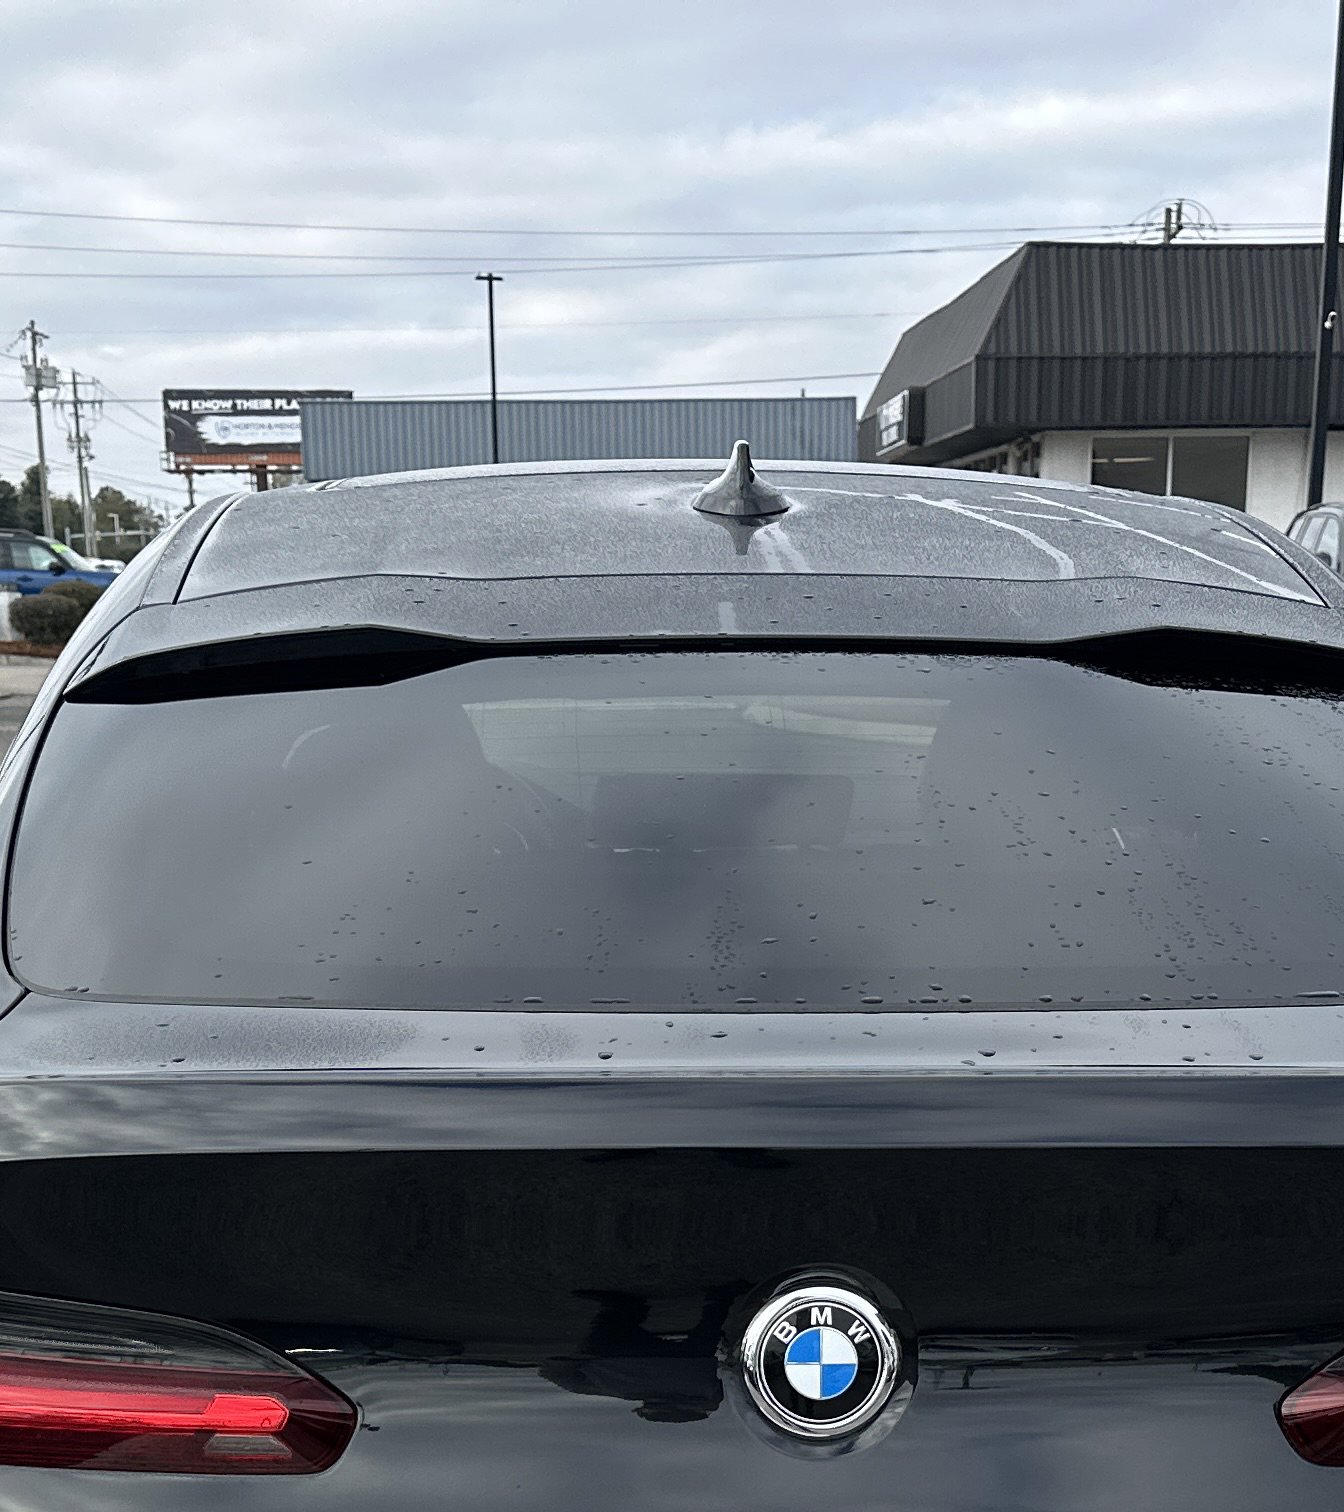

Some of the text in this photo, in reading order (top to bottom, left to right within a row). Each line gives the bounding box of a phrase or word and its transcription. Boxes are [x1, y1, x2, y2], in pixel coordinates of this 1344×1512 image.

[167, 399, 190, 412] WE
[191, 399, 234, 411] KNOW
[234, 399, 274, 410] THEIR
[772, 1306, 872, 1345] BMW
